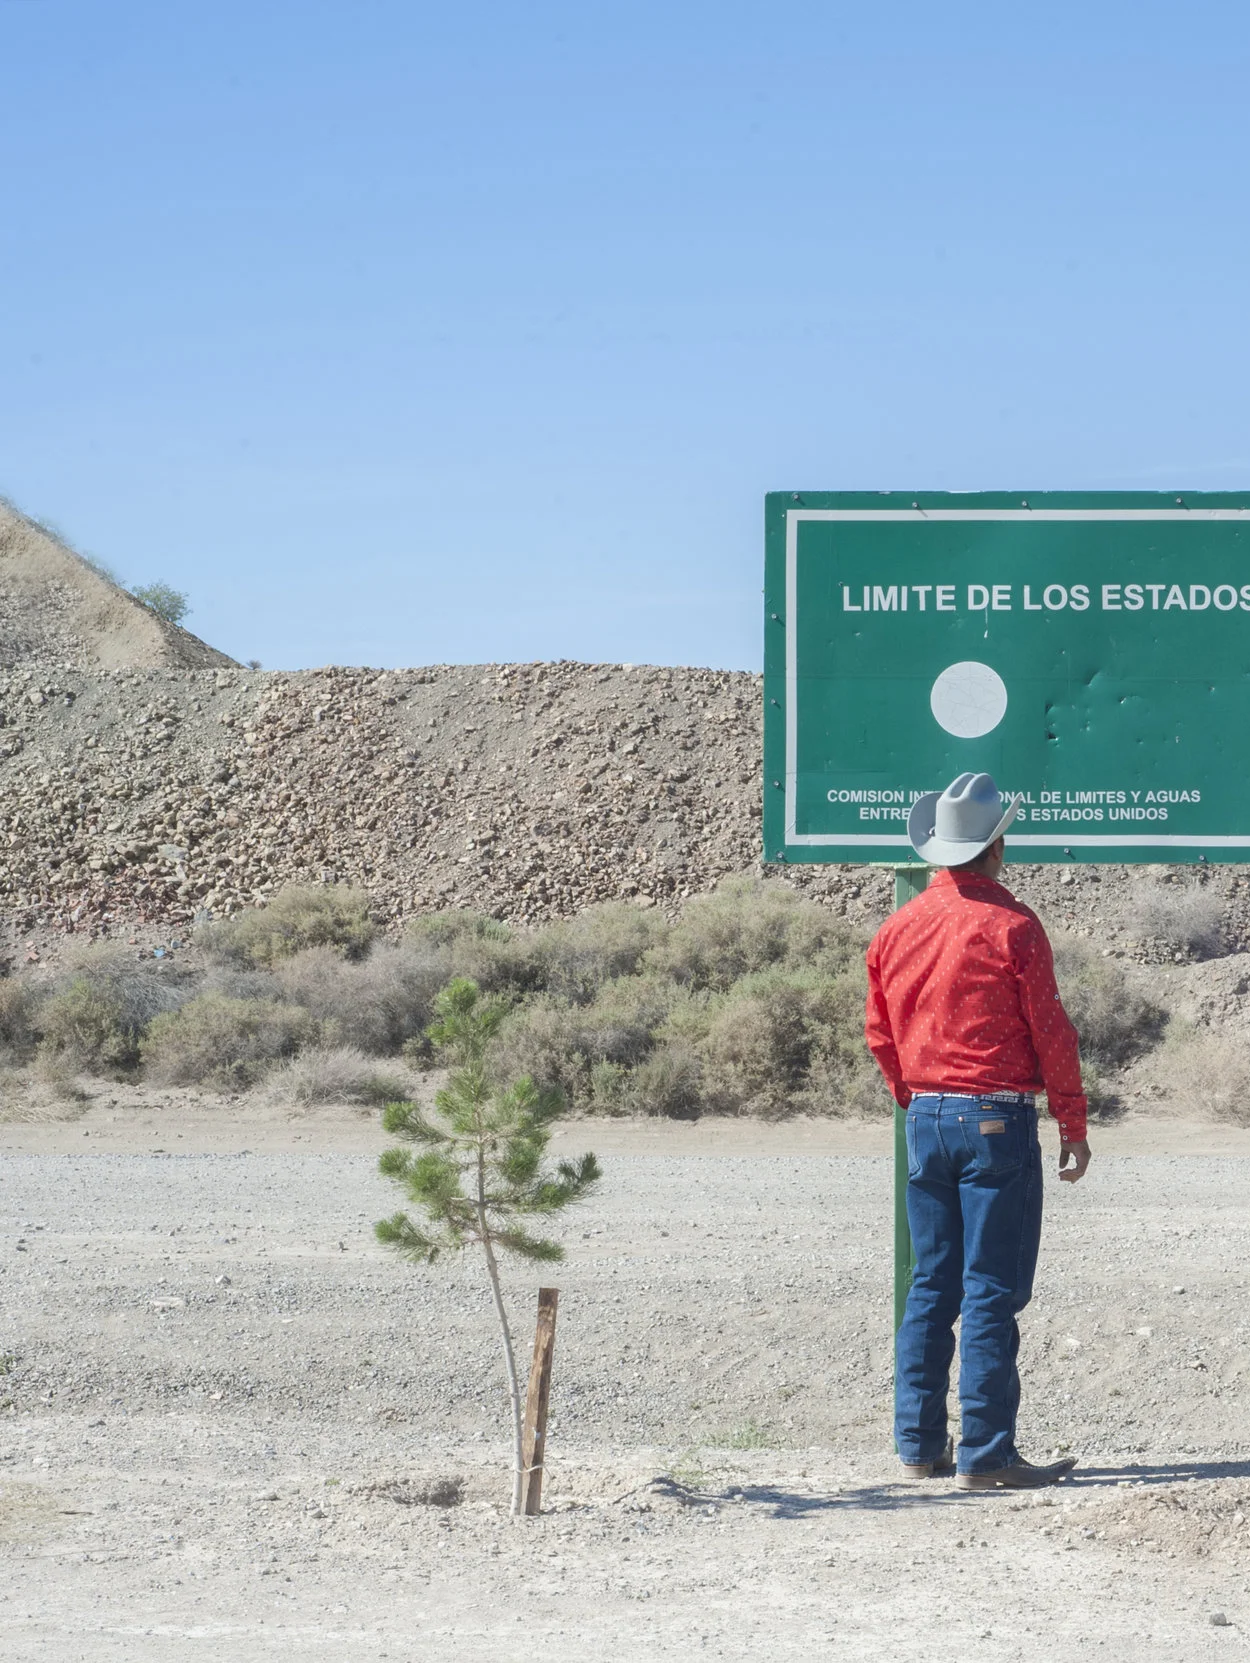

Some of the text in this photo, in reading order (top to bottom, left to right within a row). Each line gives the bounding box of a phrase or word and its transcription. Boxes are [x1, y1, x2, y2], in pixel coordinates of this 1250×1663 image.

[842, 584, 957, 612] LIMITE
[967, 584, 1012, 611] DE
[1023, 583, 1091, 611] LOS
[826, 789, 905, 803] COMISION
[1040, 791, 1062, 804] DE
[1066, 790, 1127, 804] LIMITES
[1130, 790, 1141, 803] Y
[1144, 789, 1201, 803] AGUAS
[859, 807, 911, 821] ENTRE
[1030, 807, 1104, 822] ESTADOS
[1108, 807, 1169, 821] UNIDOS
